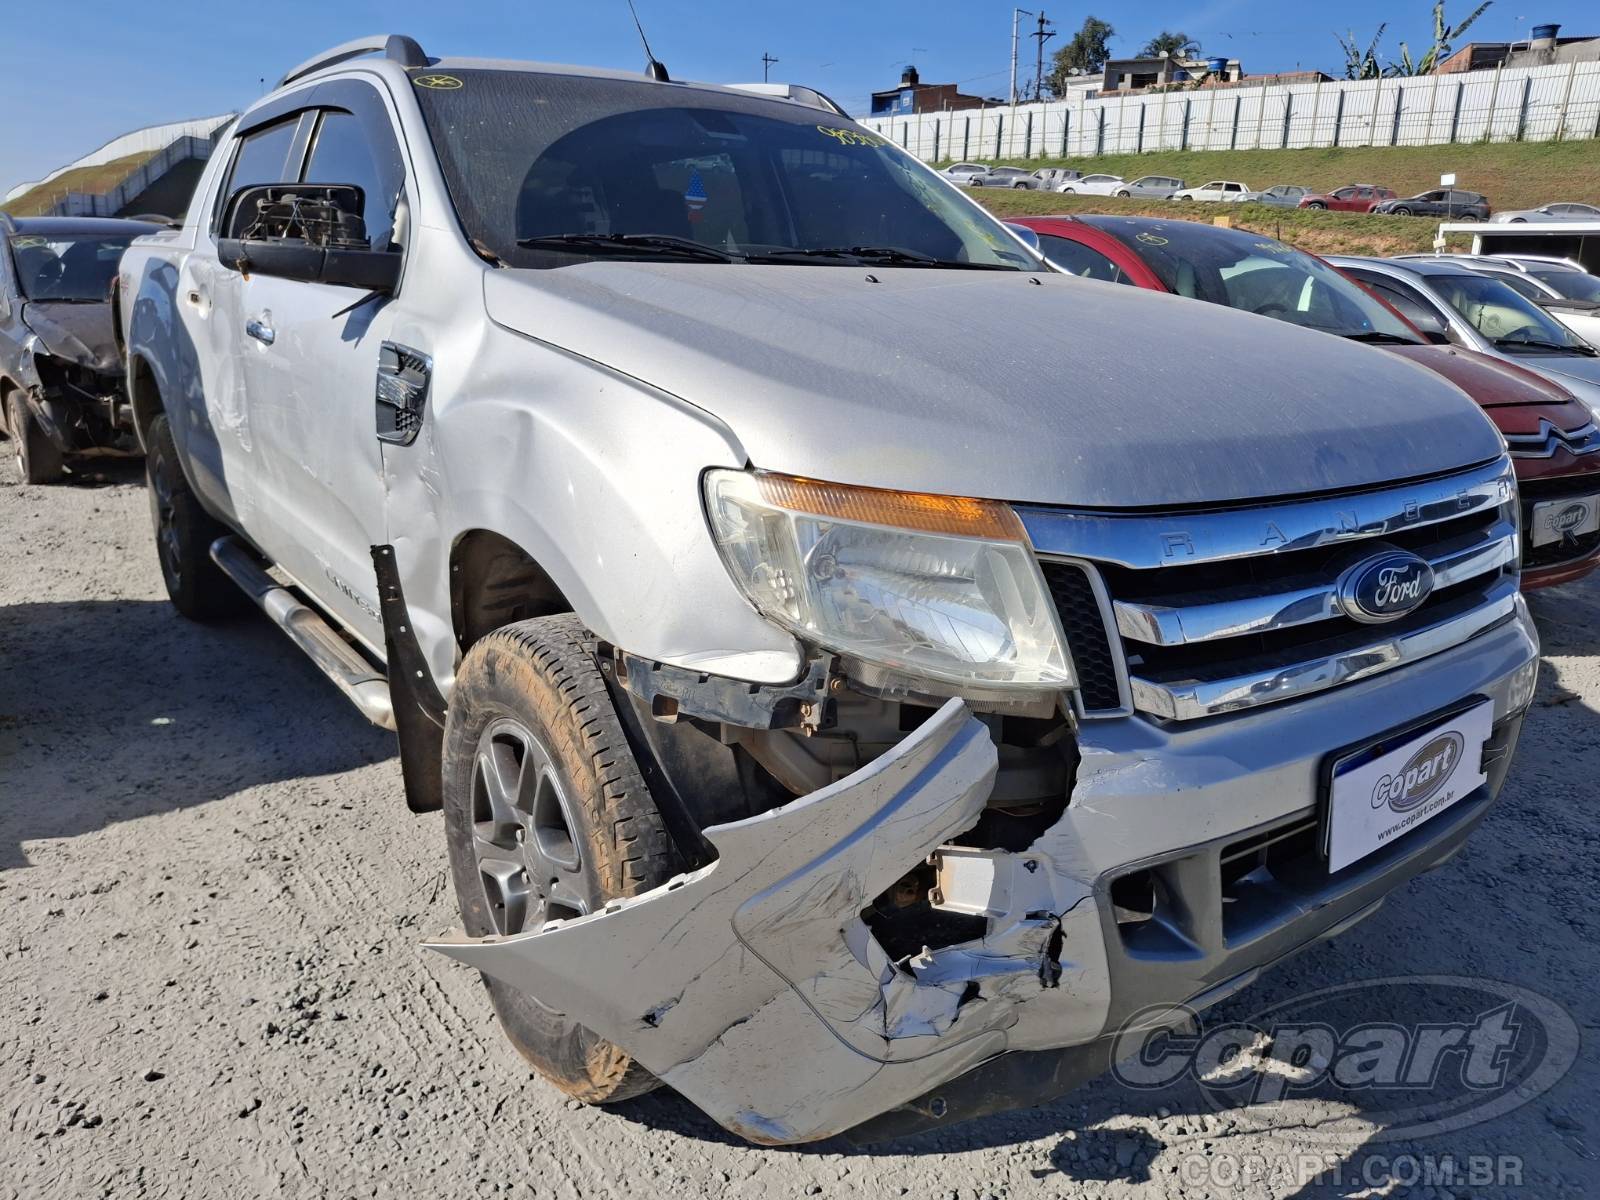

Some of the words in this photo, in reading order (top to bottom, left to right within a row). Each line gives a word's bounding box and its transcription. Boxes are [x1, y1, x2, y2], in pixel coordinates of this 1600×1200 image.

[1544, 507, 1583, 529] Copart
[1375, 565, 1421, 607] Ford
[1371, 743, 1454, 809] Copart
[1377, 790, 1455, 841] www.copart.com.br
